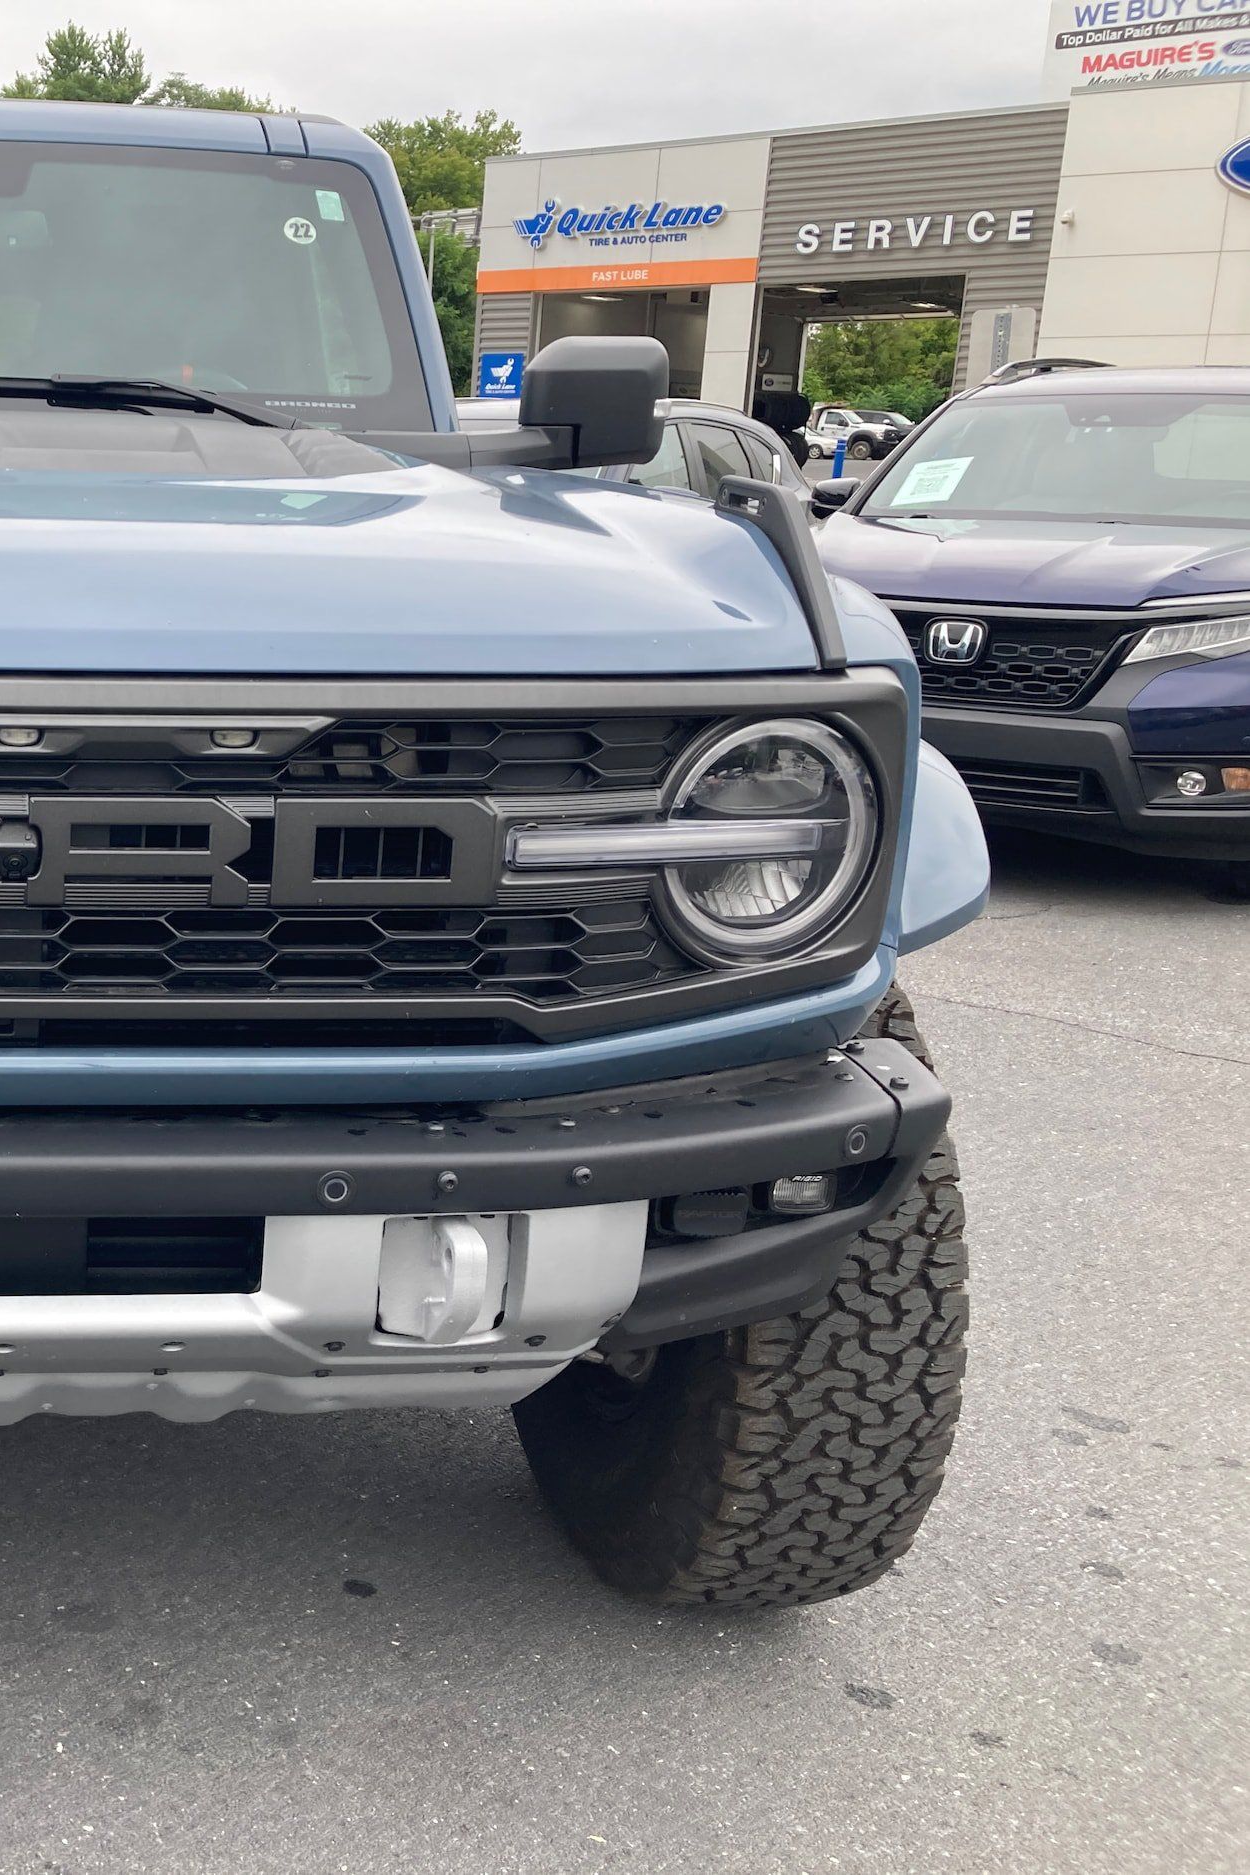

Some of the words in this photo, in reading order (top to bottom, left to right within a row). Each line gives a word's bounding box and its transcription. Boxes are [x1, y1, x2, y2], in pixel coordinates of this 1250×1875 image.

[1075, 2, 1119, 28] WE
[1126, 0, 1186, 21] BUY
[1061, 34, 1084, 47] Top
[1086, 29, 1123, 44] Dollar
[1124, 24, 1153, 39] Paid
[1155, 22, 1175, 35] for
[1174, 19, 1193, 33] All
[1082, 40, 1216, 74] MAGUIRE'S
[289, 222, 313, 238] 22
[556, 202, 642, 236] Quick
[643, 201, 724, 229] Lane
[795, 208, 1035, 255] SERVICE
[589, 237, 610, 247] TIRE
[611, 237, 619, 246] &
[620, 234, 647, 245] AUTO
[648, 233, 687, 244] CENTER
[592, 270, 618, 281] FAST
[620, 269, 649, 281] LUBE
